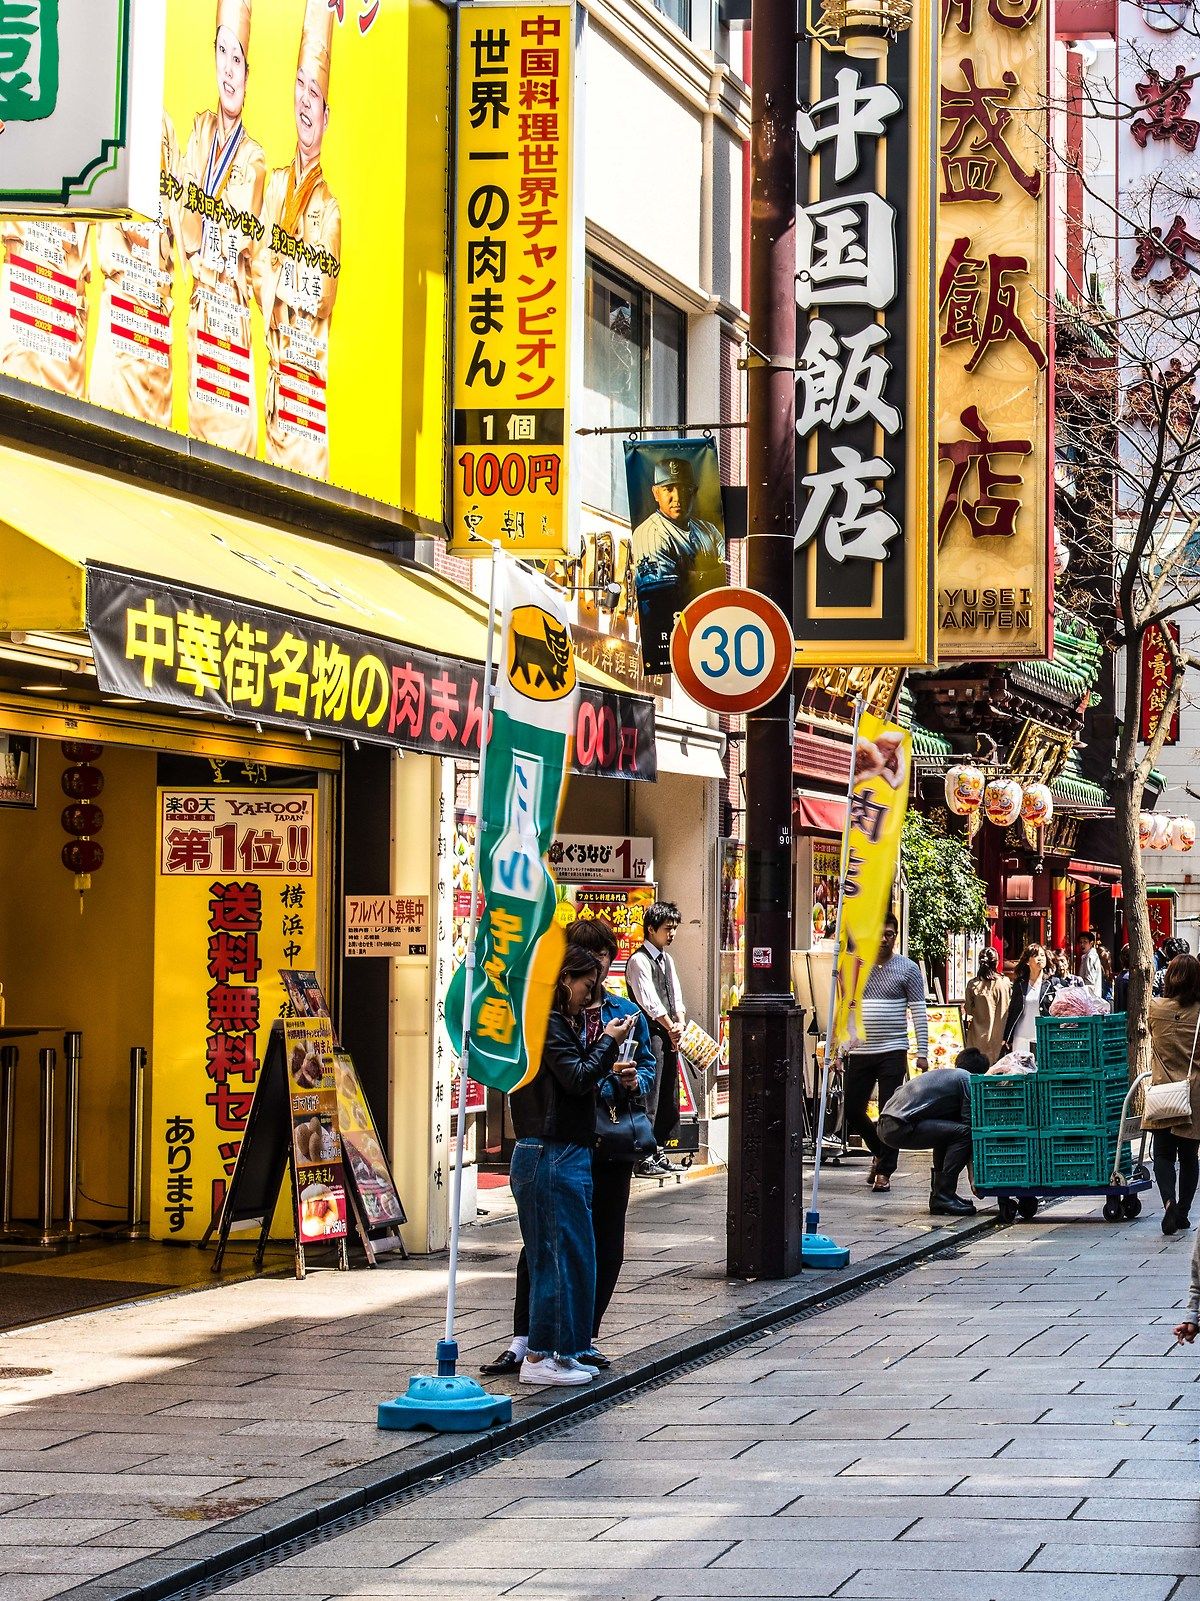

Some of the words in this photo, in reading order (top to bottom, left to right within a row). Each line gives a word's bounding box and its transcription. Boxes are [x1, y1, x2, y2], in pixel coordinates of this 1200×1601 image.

[187, 182, 265, 241] 第3回チャンピオン
[465, 29, 510, 388] 世界一の肉まん
[514, 14, 561, 401] 中国料理世界チャンピオン
[271, 224, 341, 278] 第2回チャンピオン
[938, 0, 1048, 539] 盛飯店
[795, 68, 904, 563] 中国飯店
[483, 414, 536, 440] 1個
[459, 452, 560, 496] 100円
[125, 598, 492, 750] 中華街名物の肉まん
[701, 624, 765, 678] 30
[225, 800, 307, 816] YAHOO!
[274, 814, 303, 822] JAPAN
[165, 822, 310, 872] 第1位!!
[565, 844, 613, 864] ぐるなび
[350, 899, 424, 924] アルバイト募集中
[578, 893, 627, 902] フカヒレ料理専門店
[165, 1115, 194, 1232] あります
